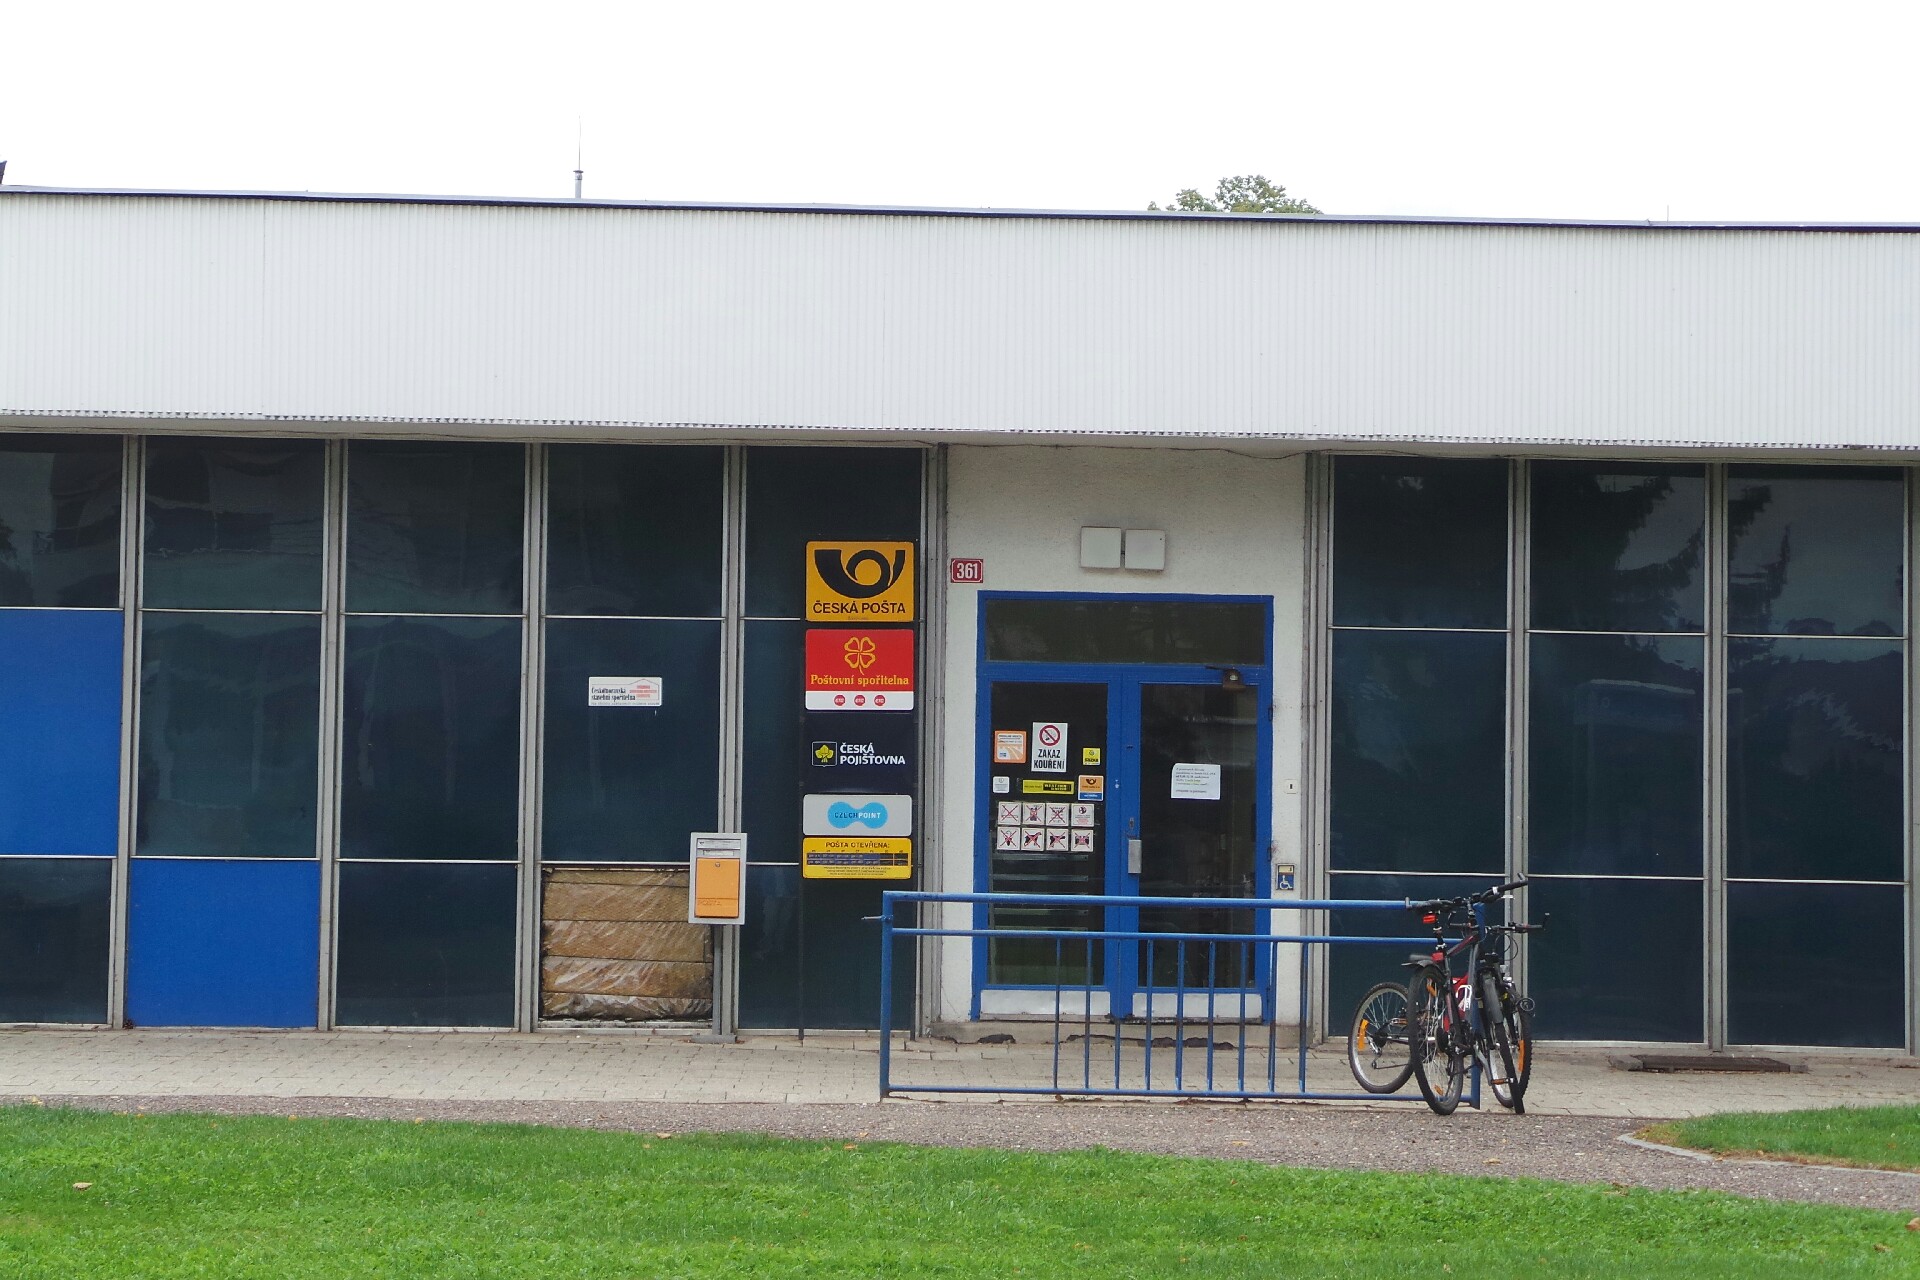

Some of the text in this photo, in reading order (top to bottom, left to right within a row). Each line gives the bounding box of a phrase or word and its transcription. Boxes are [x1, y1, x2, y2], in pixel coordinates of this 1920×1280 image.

[956, 562, 979, 580] 361
[813, 600, 906, 614] ČESKÁ POŠTA
[810, 674, 909, 687] Poštovní spořitelna
[839, 741, 875, 754] ČESKÁ
[839, 753, 906, 766] POJIŠŤOVNA
